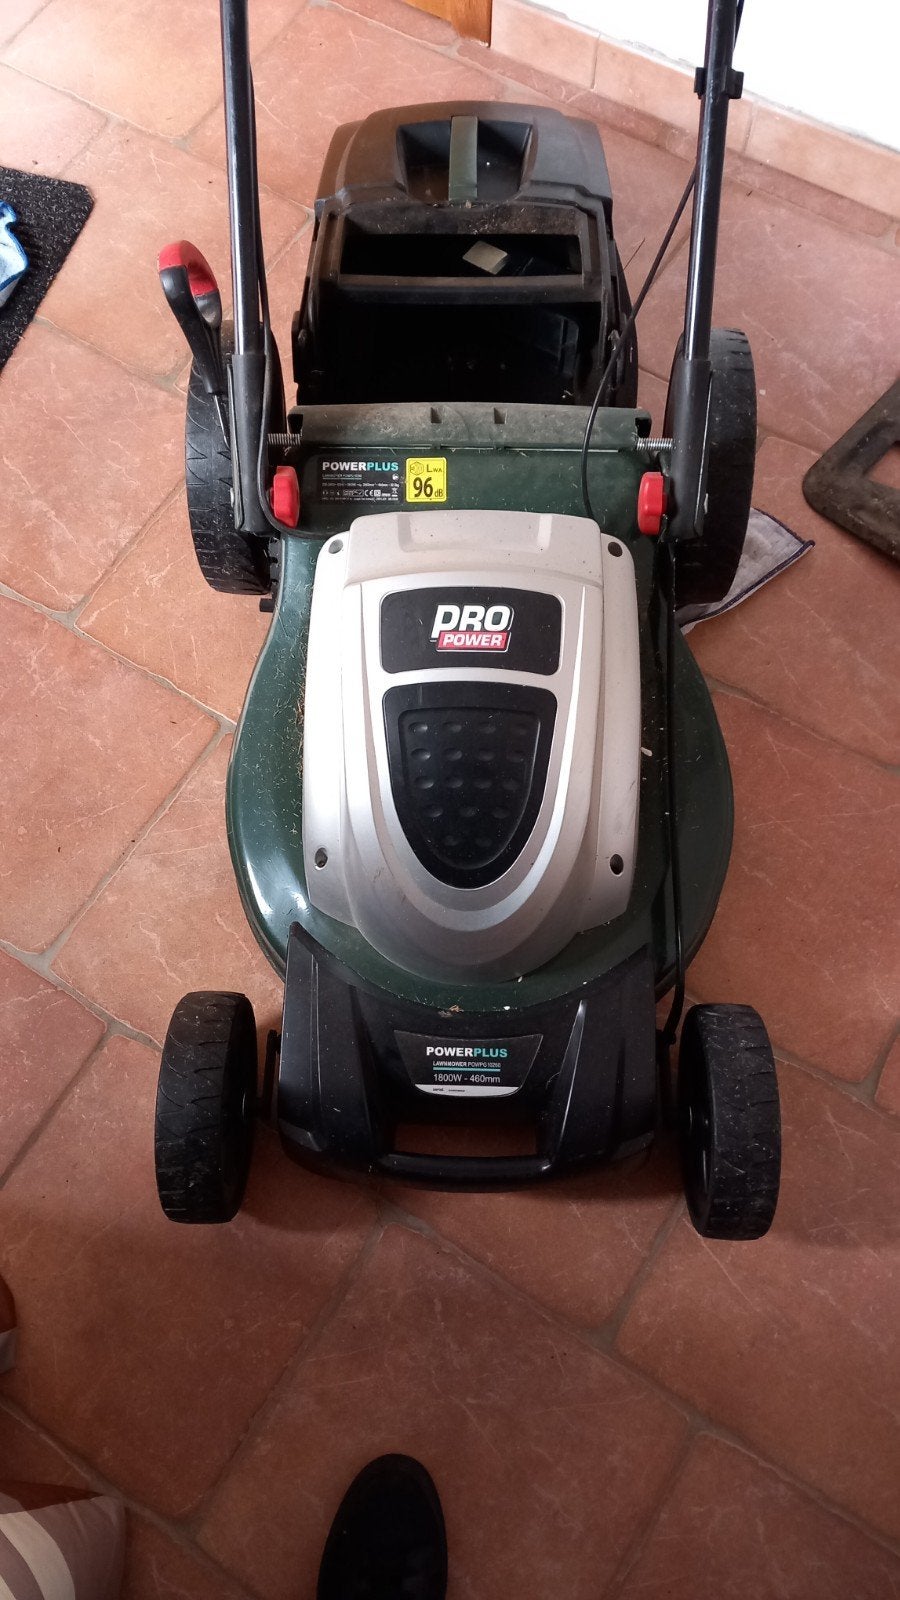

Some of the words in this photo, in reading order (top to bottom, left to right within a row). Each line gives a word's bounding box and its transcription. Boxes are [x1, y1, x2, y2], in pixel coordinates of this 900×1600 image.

[322, 461, 399, 471] POWERPLUS
[413, 476, 434, 498] 96
[430, 604, 511, 639] PRO
[442, 633, 503, 647] POWER
[426, 1046, 508, 1058] POWERPLUS
[432, 1060, 467, 1068] LAWNMOWER
[433, 1073, 463, 1083] 1800W
[469, 1074, 501, 1084] 460mm
